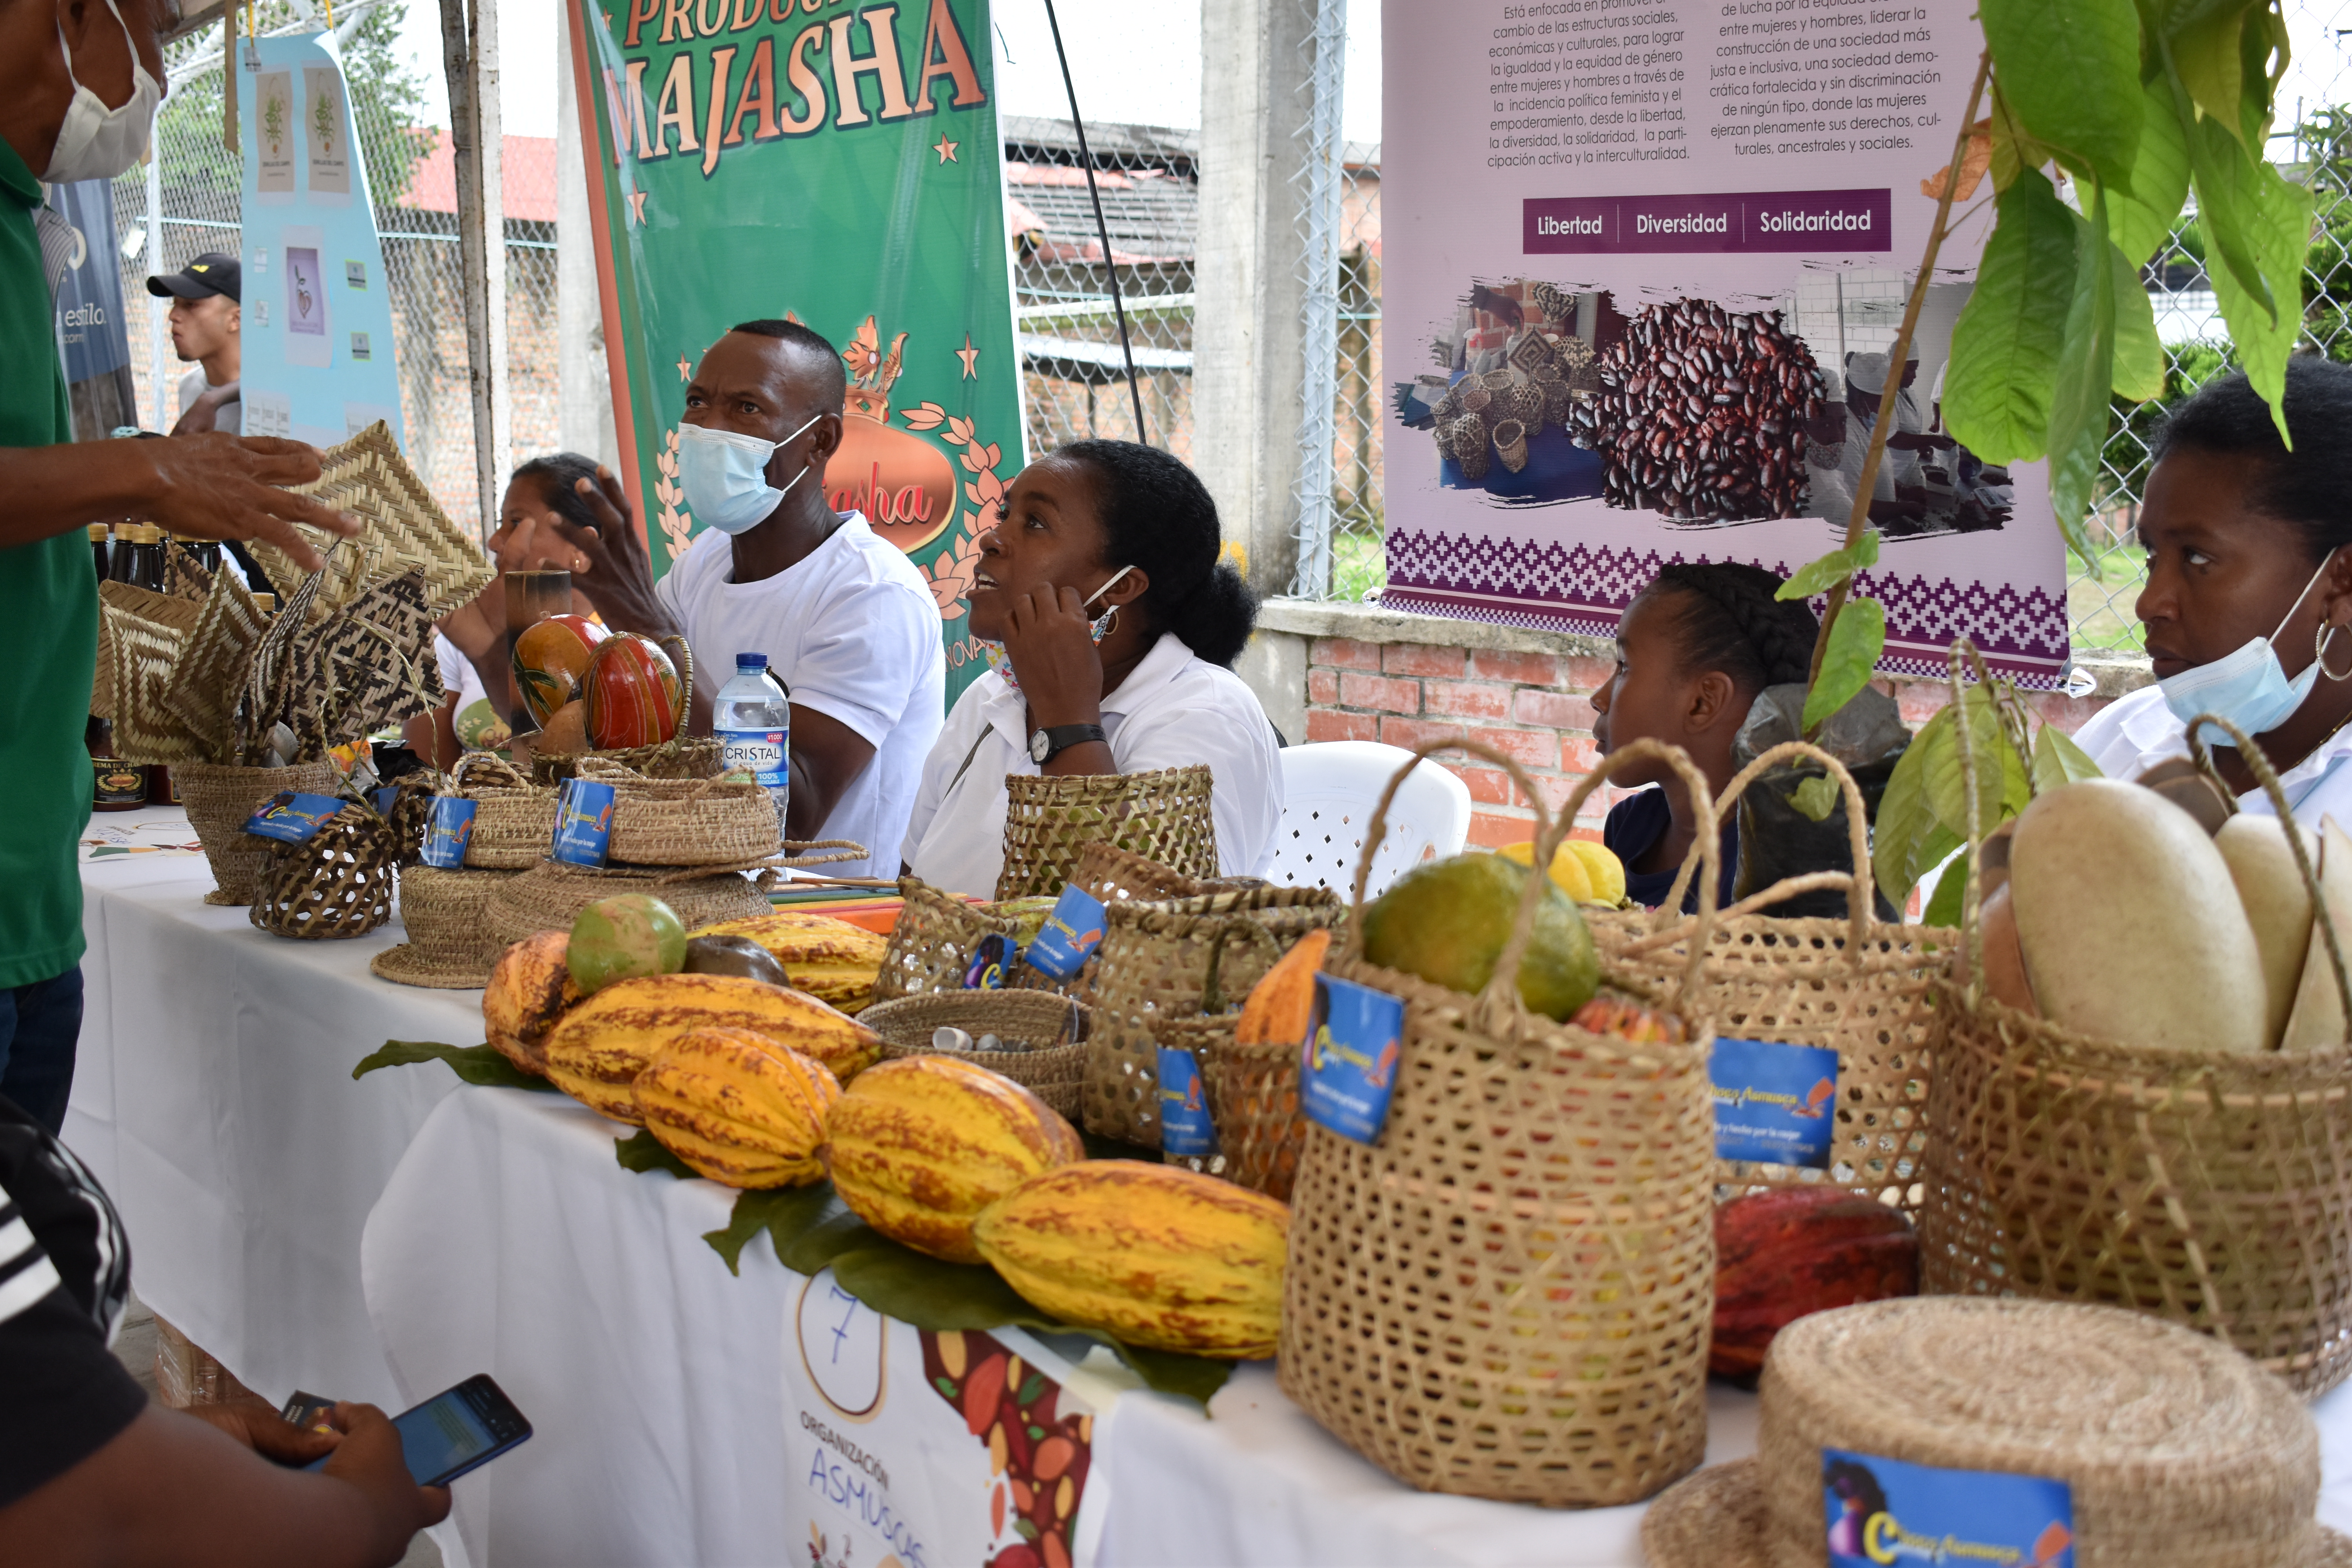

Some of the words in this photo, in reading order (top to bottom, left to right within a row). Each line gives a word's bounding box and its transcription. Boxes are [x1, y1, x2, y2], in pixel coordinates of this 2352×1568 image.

[1504, 4, 1525, 20] Está
[1528, 2, 1581, 17] enfocada
[1584, 0, 1598, 11] en
[1721, 3, 1737, 16] de
[1740, 0, 1772, 15] lucha
[1775, 0, 1796, 14] por
[1798, 0, 1809, 9] la
[623, 0, 851, 46] PROD
[1493, 23, 1535, 39] cambio
[1537, 22, 1552, 35] de
[1555, 20, 1569, 33] las
[1572, 16, 1630, 32] estructuras
[1632, 10, 1678, 26] sociales,
[1719, 23, 1749, 36] entre
[1752, 19, 1797, 36] mujeres
[1800, 20, 1807, 33] y
[1810, 13, 1866, 29] hombres,
[1870, 9, 1911, 24] liderar
[1914, 7, 1926, 20] la
[1489, 41, 1555, 58] económicas
[1557, 42, 1564, 55] y
[1566, 35, 1620, 51] culturales,
[1623, 34, 1649, 49] para
[1652, 31, 1684, 46] lograr
[1716, 38, 1790, 57] construcción
[1793, 37, 1810, 51] de
[1813, 38, 1837, 49] una
[1840, 29, 1900, 47] sociedad
[1904, 27, 1931, 42] más
[1491, 63, 1500, 76] la
[1503, 59, 1551, 78] igualdad
[1554, 61, 1561, 74] y
[1563, 57, 1573, 70] la
[1575, 53, 1622, 71] equidad
[1625, 52, 1640, 65] de
[1643, 49, 1683, 67] género
[1710, 64, 1736, 80] justa
[1739, 65, 1746, 75] e
[1749, 59, 1801, 74] inclusiva,
[1805, 59, 1828, 71] una
[1831, 51, 1891, 69] sociedad
[1895, 50, 1939, 64] demo-
[602, 0, 986, 179] MAJASHA
[1490, 81, 1518, 94] entre
[1521, 78, 1561, 94] mujeres
[1564, 79, 1570, 92] y
[1573, 74, 1620, 88] hombres
[1622, 74, 1630, 85] a
[1633, 68, 1666, 84] través
[1669, 68, 1684, 82] de
[1710, 83, 1749, 97] crática
[1752, 78, 1817, 94] fortalecida
[1820, 80, 1827, 93] y
[1830, 76, 1845, 90] sin
[1849, 69, 1941, 88] discriminación
[1494, 100, 1503, 112] la
[1509, 95, 1565, 111] incidencia
[1568, 93, 1608, 111] política
[1610, 89, 1659, 105] feminista
[1662, 91, 1669, 105] y
[1671, 87, 1681, 101] el
[1722, 103, 1737, 116] de
[1740, 100, 1779, 117] ningún
[1782, 100, 1808, 115] tipo,
[1812, 96, 1853, 111] donde
[1857, 95, 1873, 109] las
[1877, 93, 1927, 110] mujeres
[1490, 113, 1587, 132] empoderamiento,
[1590, 111, 1624, 125] desde
[1627, 110, 1637, 123] la
[1640, 107, 1686, 122] libertad,
[1711, 123, 1750, 140] ejerzan
[1753, 119, 1826, 137] plenamente
[1829, 120, 1846, 131] sus
[1850, 114, 1913, 130] derechos,
[1917, 112, 1941, 126] cul-
[1490, 136, 1499, 149] la
[1503, 133, 1560, 148] diversidad,
[1563, 132, 1573, 145] la
[1575, 129, 1638, 145] solidaridad,
[1644, 128, 1655, 141] la
[1658, 126, 1687, 143] parti-
[1734, 142, 1774, 155] turales,
[1777, 138, 1846, 154] ancestrales
[1849, 140, 1856, 154] y
[1859, 135, 1913, 150] sociales.
[1487, 152, 1535, 169] cipación
[1538, 151, 1572, 165] activa
[1575, 154, 1581, 166] y
[1584, 150, 1593, 163] la
[1596, 145, 1690, 162] interculturalidad.
[1538, 215, 1602, 235] Libertad
[1637, 212, 1727, 234] Diversidad
[1760, 209, 1871, 232] Solidaridad
[65, 303, 107, 327] esilo.
[822, 461, 933, 524] asha
[725, 747, 781, 760] CRISTAL
[829, 1285, 858, 1364] 7
[800, 1410, 890, 1491] ORGANIZACIÓN
